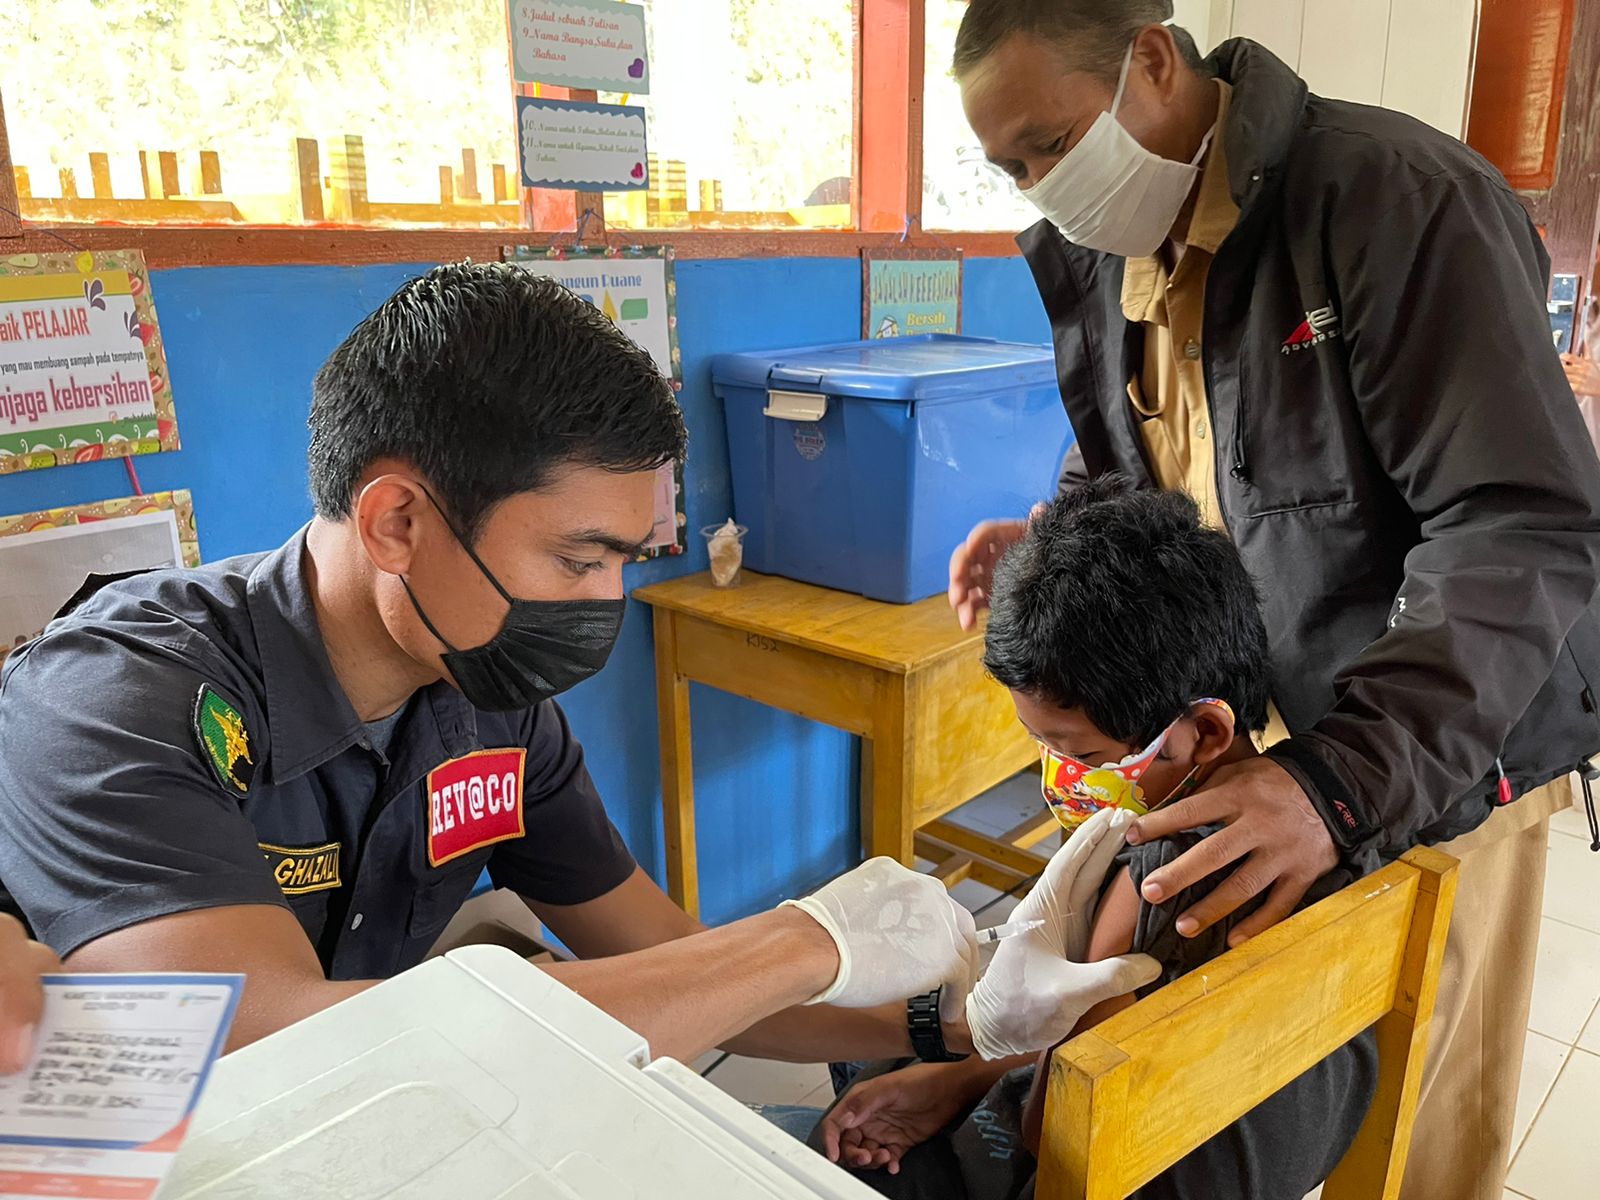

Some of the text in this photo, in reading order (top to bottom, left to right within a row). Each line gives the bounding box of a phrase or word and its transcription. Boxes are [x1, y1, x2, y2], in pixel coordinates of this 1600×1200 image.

[558, 14, 586, 26] sebuah
[588, 17, 619, 30] Tulisan
[532, 48, 566, 61] Bahasa
[601, 274, 642, 288] Ruang
[22, 307, 90, 340] PELAJAR
[907, 312, 945, 326] Bersih
[1, 351, 144, 375] yang mau membuang sampah pada tempatnya
[49, 371, 150, 412] kebersihan
[431, 771, 516, 837] REV@CO
[273, 852, 337, 886] GHAZALI
